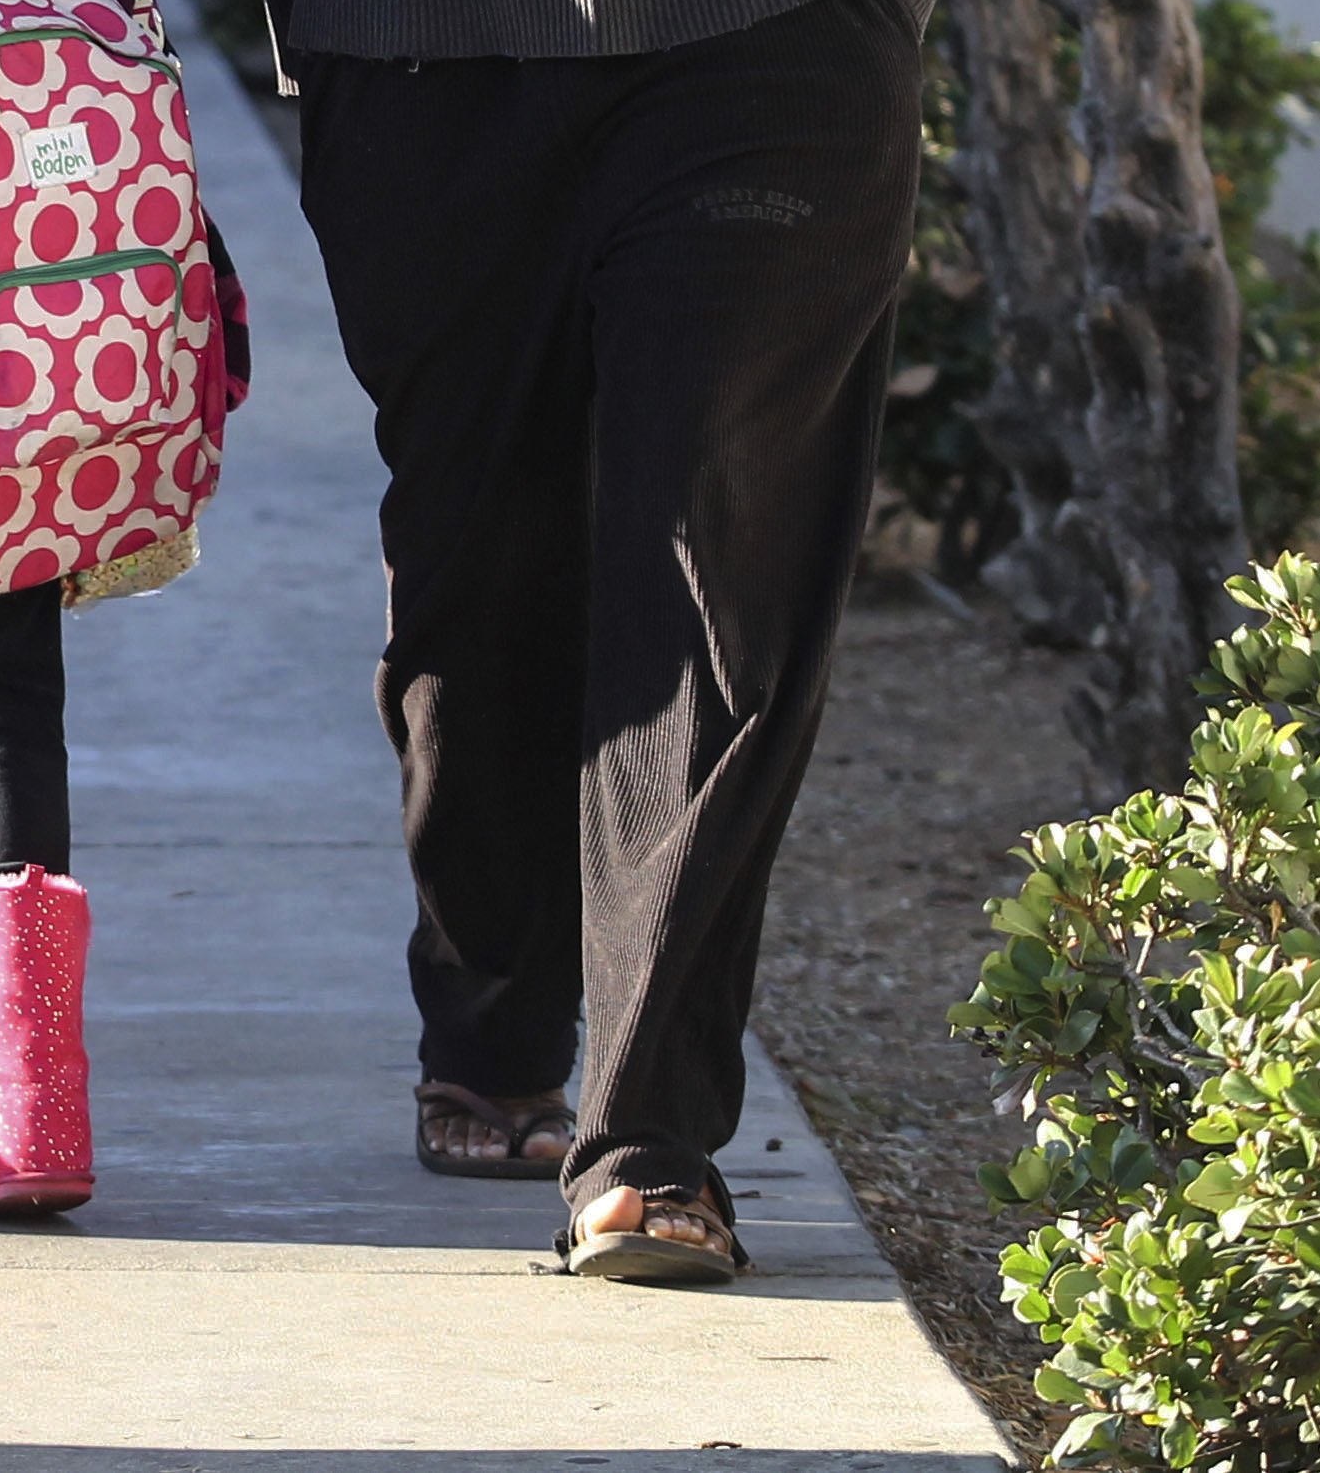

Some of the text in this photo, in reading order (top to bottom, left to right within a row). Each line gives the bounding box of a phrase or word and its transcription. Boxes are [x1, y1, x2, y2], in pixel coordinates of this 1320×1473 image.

[31, 151, 88, 180] Boden
[709, 204, 795, 227] AMERICA
[764, 189, 815, 217] ELLIS
